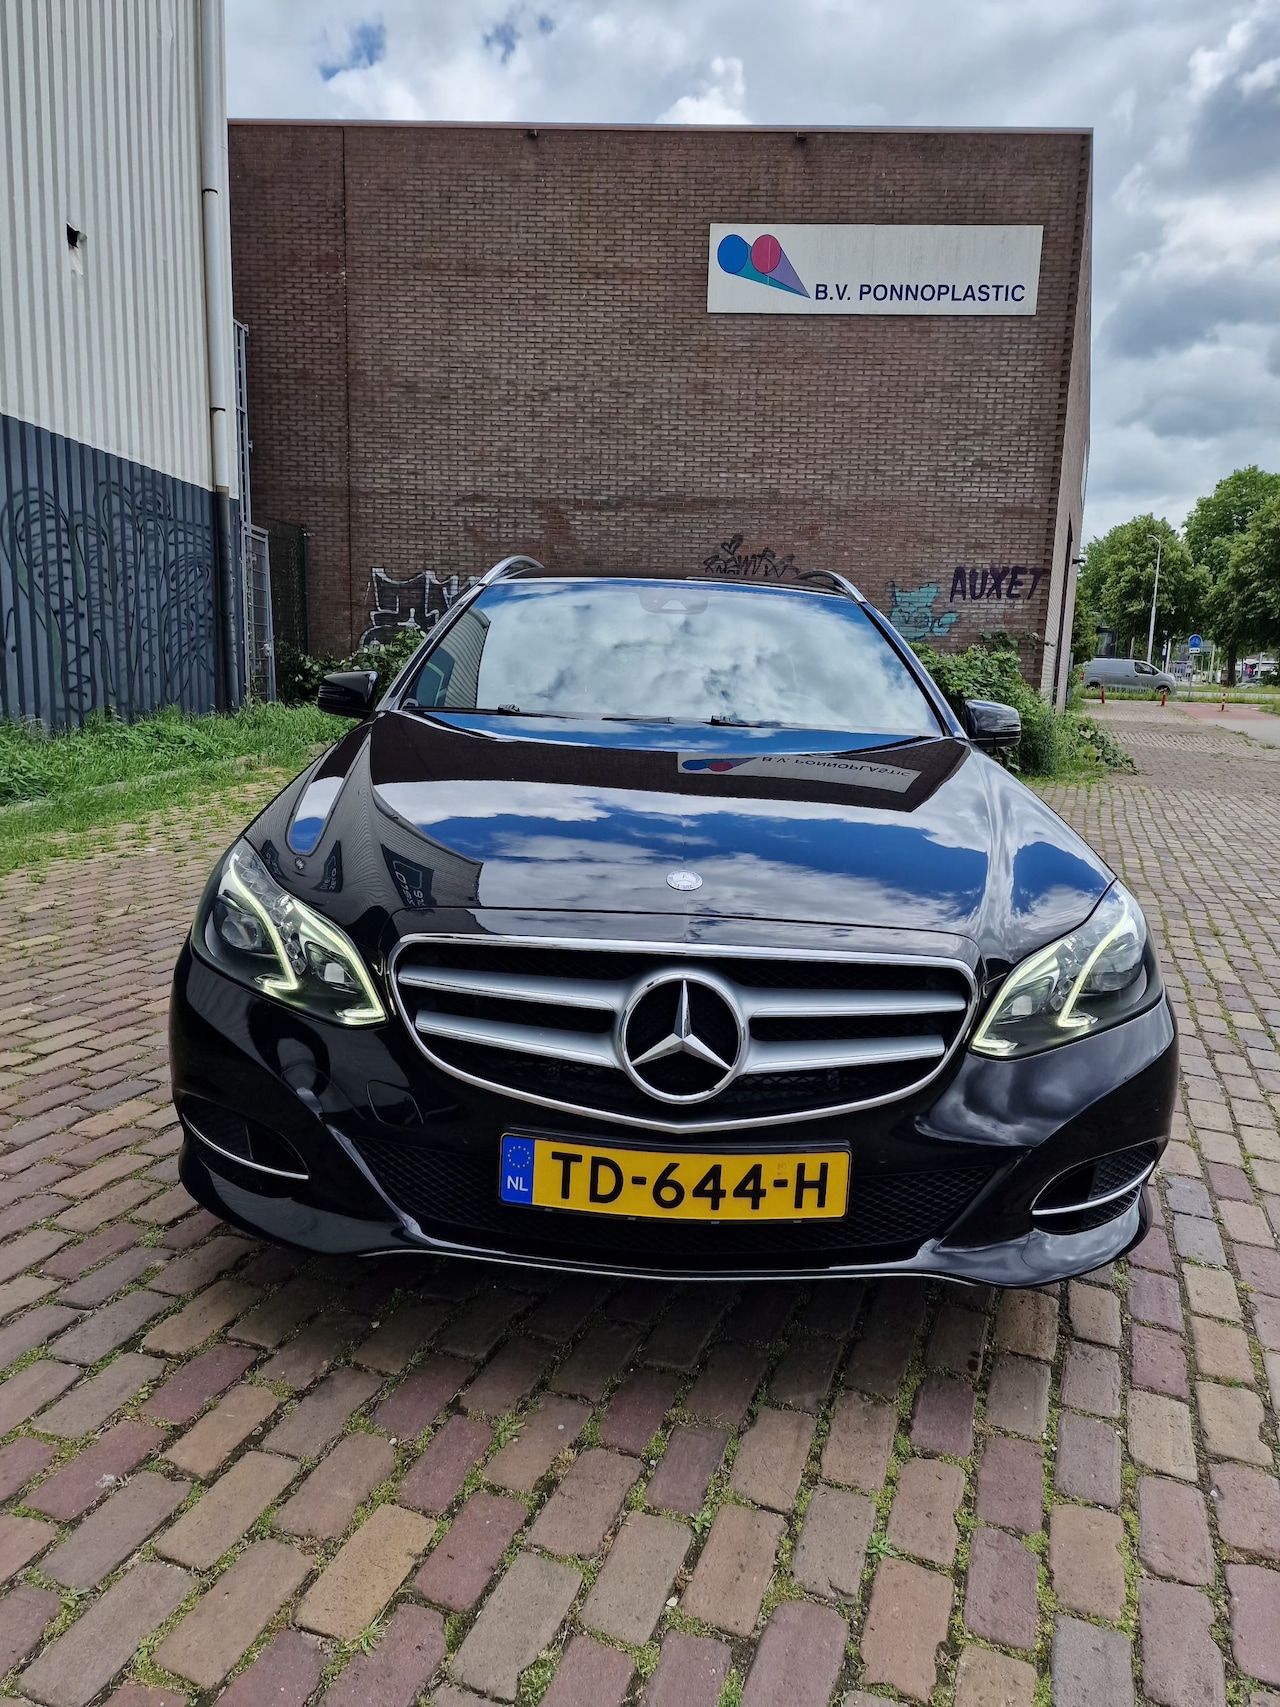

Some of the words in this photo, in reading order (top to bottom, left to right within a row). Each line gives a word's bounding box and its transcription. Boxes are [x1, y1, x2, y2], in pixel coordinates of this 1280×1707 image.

[815, 283, 851, 301] B.V.
[859, 283, 1026, 302] PONNOPLASTIC
[506, 1174, 529, 1193] NL
[551, 1151, 829, 1211] TD-644-H
